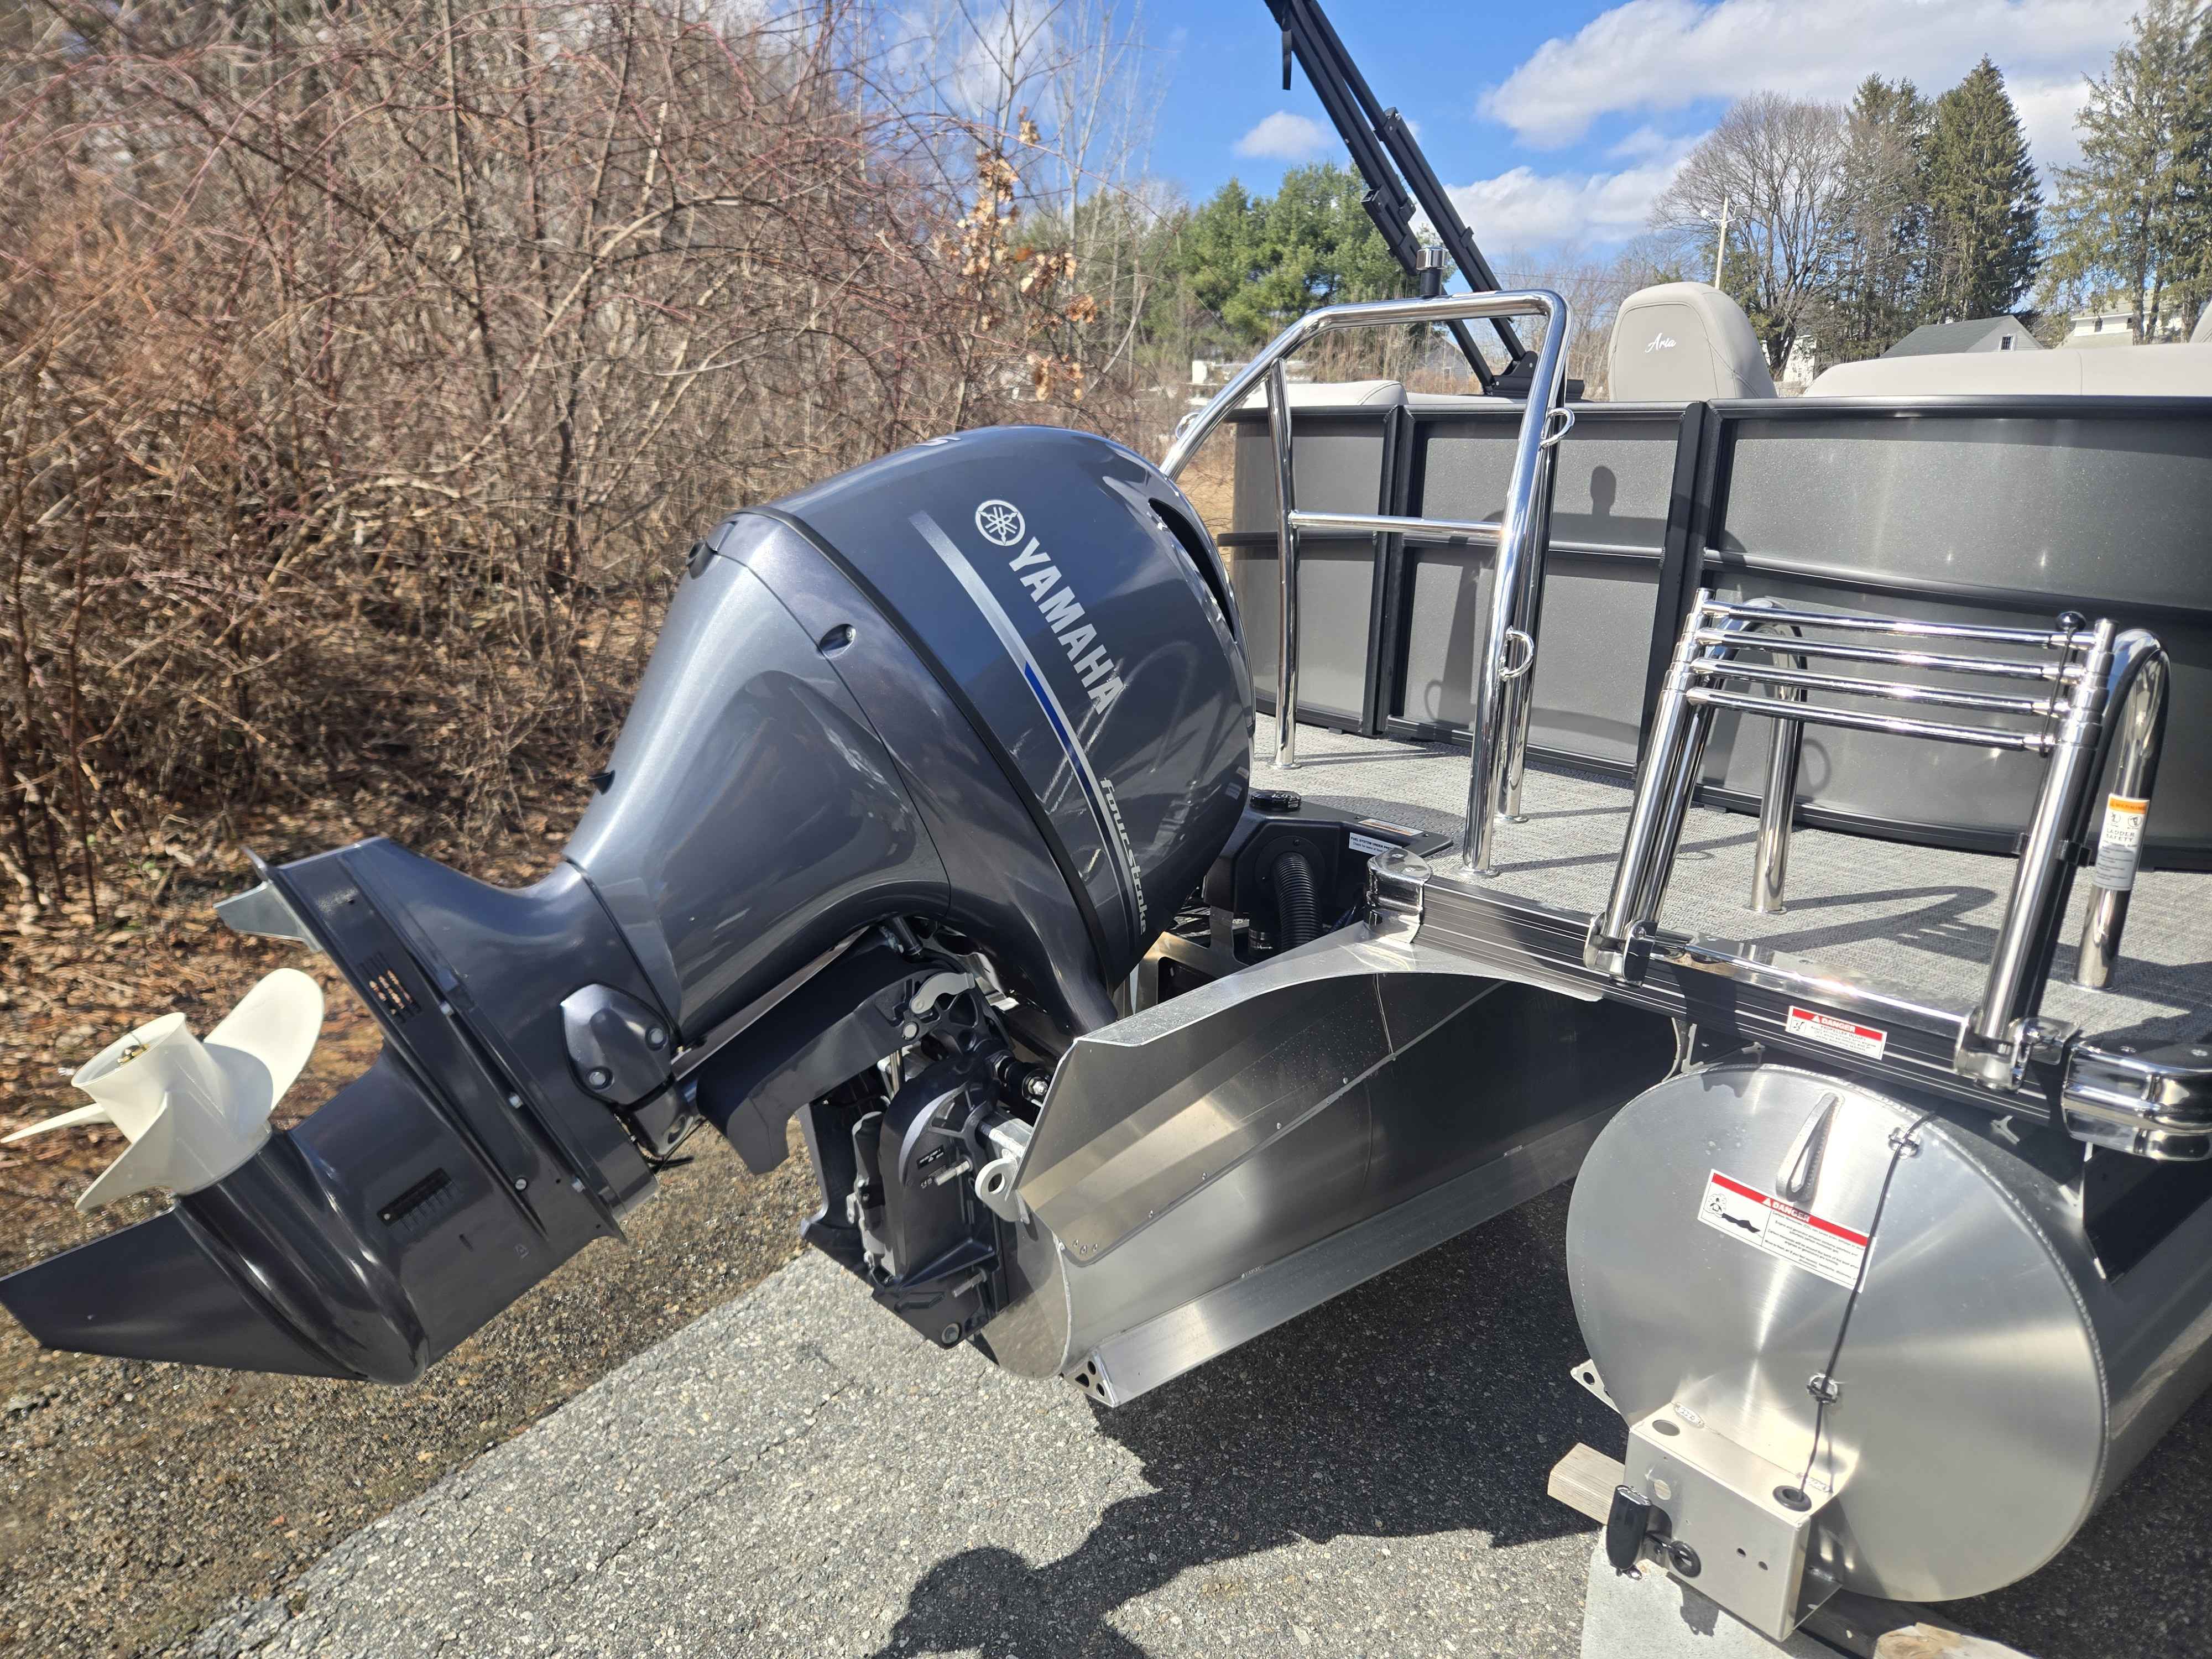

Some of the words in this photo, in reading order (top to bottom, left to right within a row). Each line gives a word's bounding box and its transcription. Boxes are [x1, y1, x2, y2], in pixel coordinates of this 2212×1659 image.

[1645, 332, 1677, 353] Aria
[1009, 536, 1128, 715] YAMAHA
[1821, 1018, 1855, 1033] DANGER
[1772, 1203, 1810, 1223] DANGER
